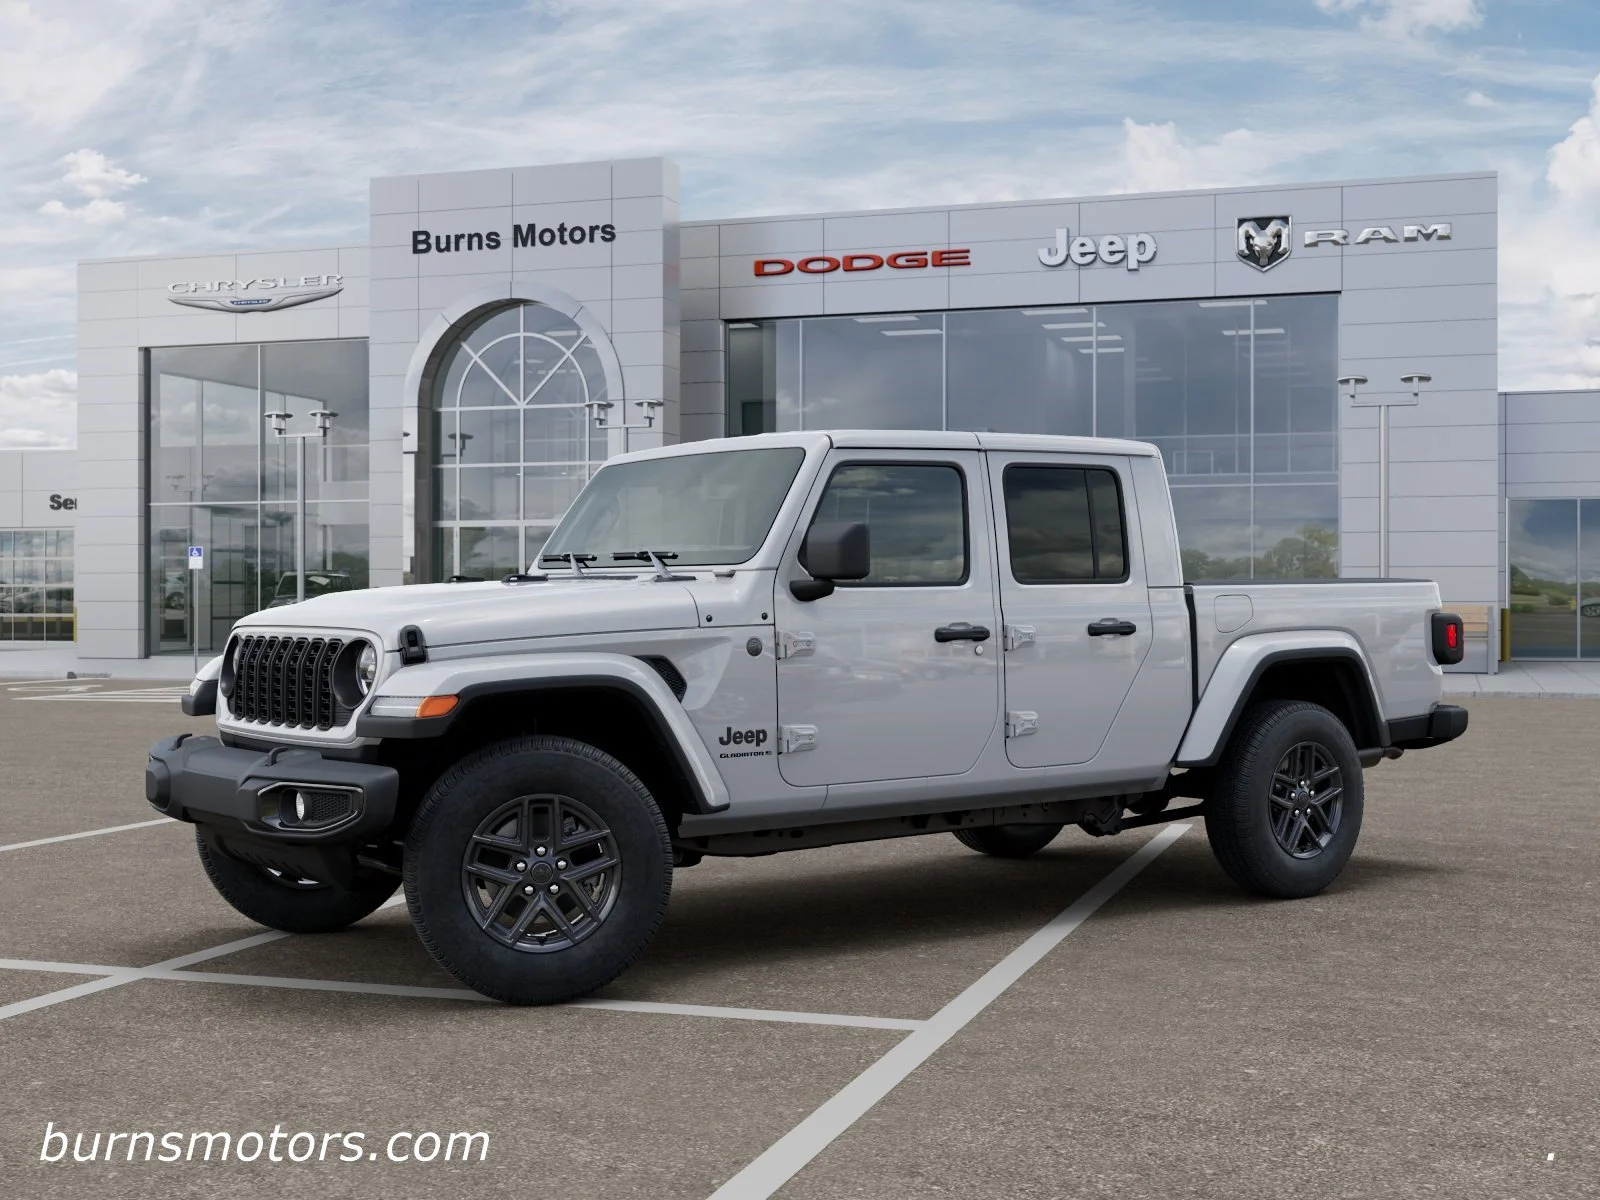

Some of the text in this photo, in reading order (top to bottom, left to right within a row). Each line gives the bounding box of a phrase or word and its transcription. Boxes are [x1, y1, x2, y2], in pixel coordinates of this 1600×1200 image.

[412, 222, 616, 254] Burns Motors
[1304, 222, 1452, 248] RAM
[1038, 227, 1157, 272] Jeep
[754, 248, 971, 277] DODGE
[167, 273, 344, 294] CHRYSLER
[49, 493, 78, 511] Se
[718, 726, 768, 747] Jeep
[719, 751, 764, 759] GLADIATOR
